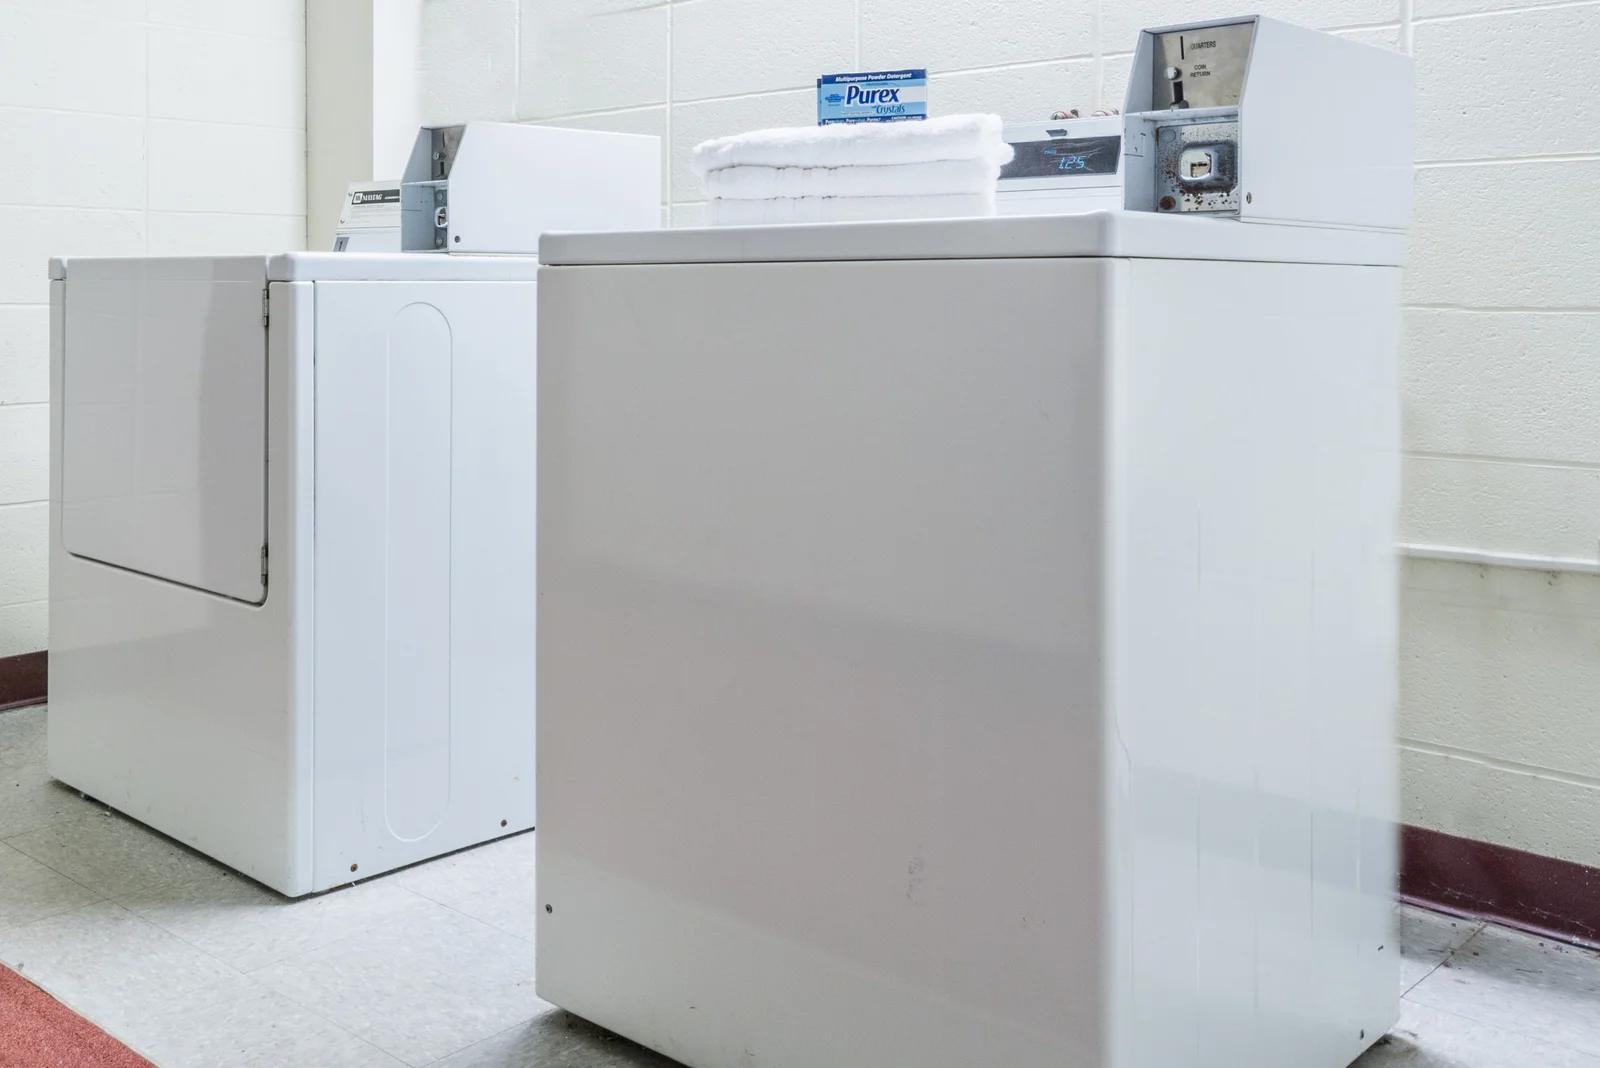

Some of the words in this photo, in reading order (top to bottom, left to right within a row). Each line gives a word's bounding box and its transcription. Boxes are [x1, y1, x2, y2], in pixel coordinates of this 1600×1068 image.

[1190, 41, 1216, 50] QUARTERS
[846, 85, 900, 105] Purex
[876, 104, 905, 114] Crystals
